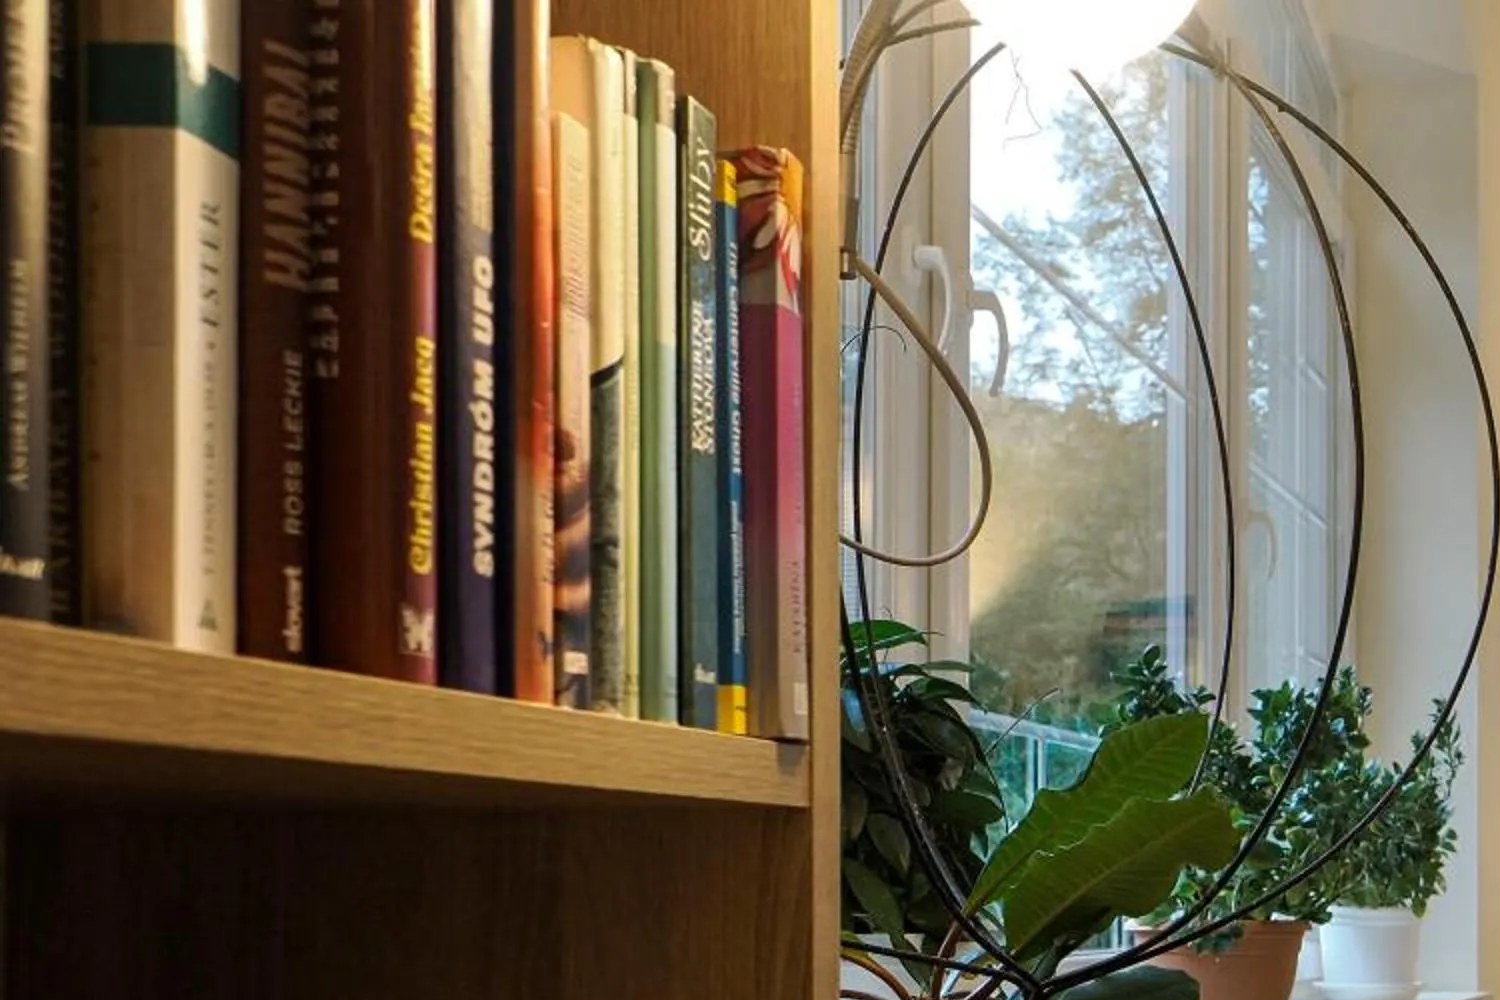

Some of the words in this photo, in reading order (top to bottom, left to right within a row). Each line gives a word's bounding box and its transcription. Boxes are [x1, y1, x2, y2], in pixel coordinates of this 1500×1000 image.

[199, 202, 222, 328] ESTER
[472, 253, 494, 348] UFO
[410, 335, 436, 415] Jacq
[729, 285, 741, 405] Canterville
[282, 348, 303, 453] LECKIE
[731, 409, 742, 476] Ghost
[282, 460, 303, 536] ROSS
[408, 421, 435, 577] Christian
[467, 358, 494, 579] SYNDRÓM
[282, 564, 304, 654] slovart
